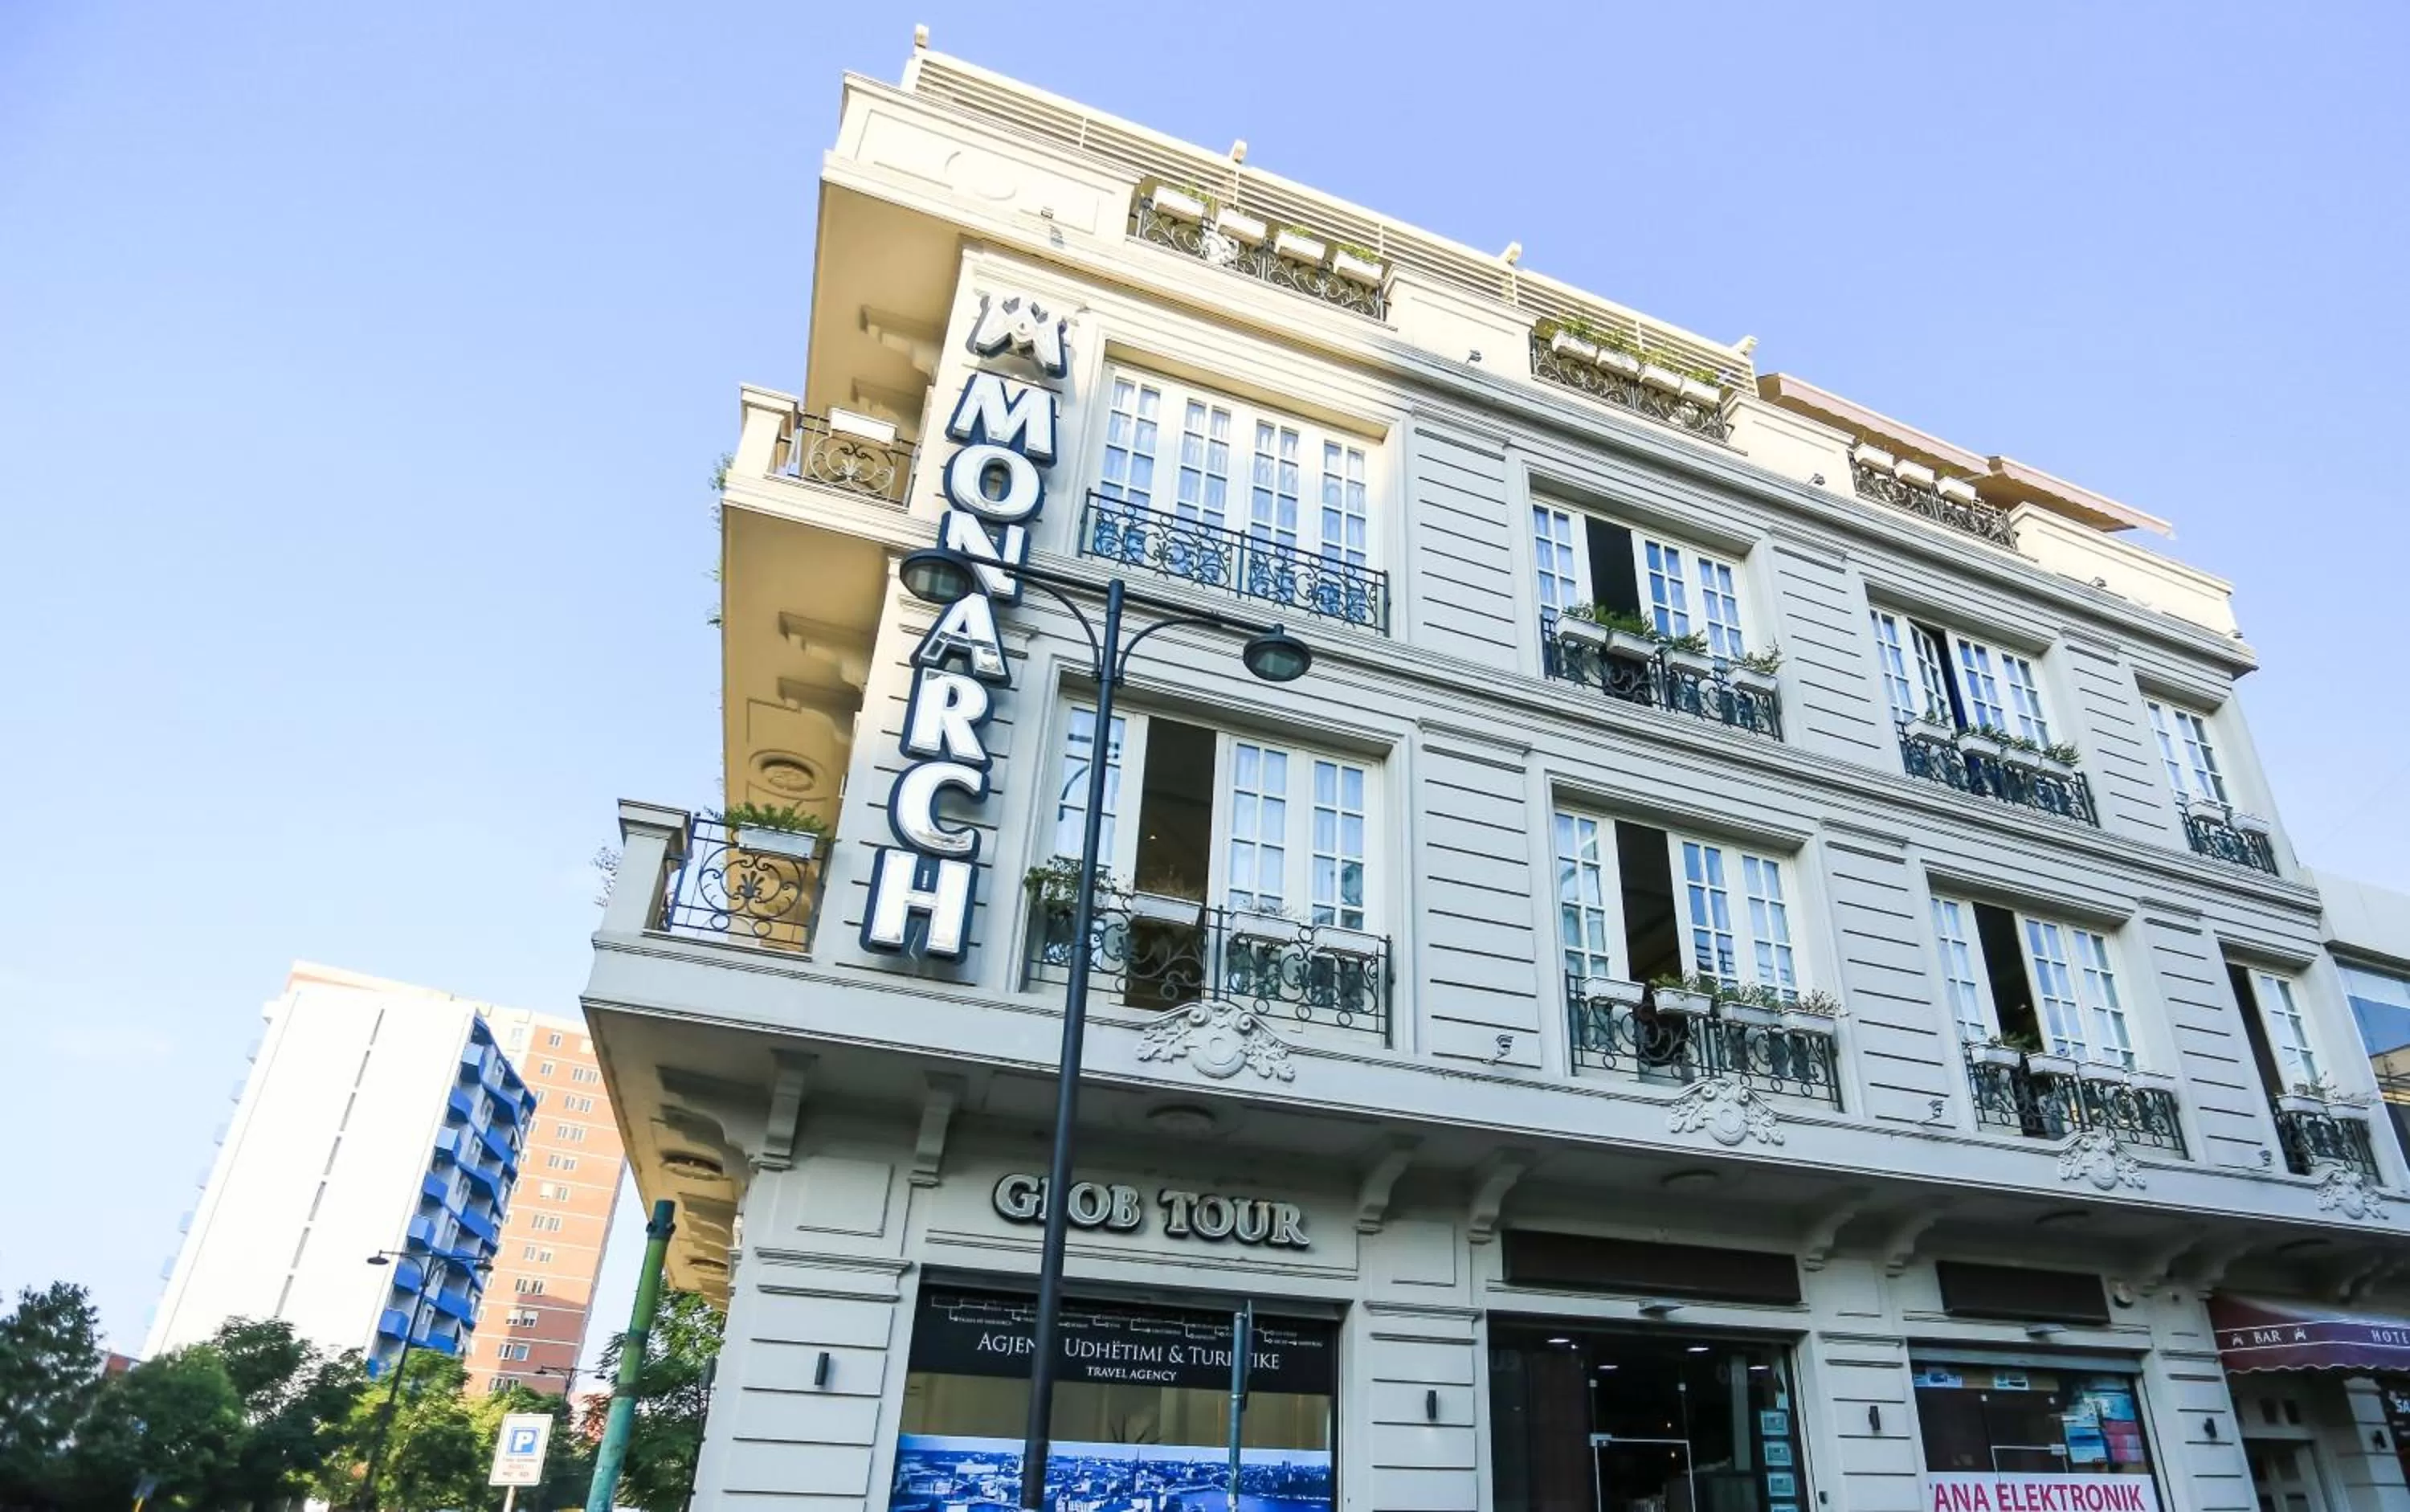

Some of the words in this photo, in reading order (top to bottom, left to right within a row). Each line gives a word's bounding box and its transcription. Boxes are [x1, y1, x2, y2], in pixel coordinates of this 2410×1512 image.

[861, 370, 1058, 962] MONARCH
[1158, 1188, 1311, 1249] TOUR
[976, 1331, 1036, 1356] AGJEN
[1064, 1337, 1162, 1363] UDHËTIMI
[1168, 1344, 1185, 1364] &
[1188, 1346, 1281, 1370] TURIIKE
[2253, 1330, 2281, 1343] BAR
[1086, 1366, 1128, 1379] TRAVEL
[1129, 1368, 1177, 1382] AGENCY
[1995, 1483, 2146, 1512] ELEKTRONIK
